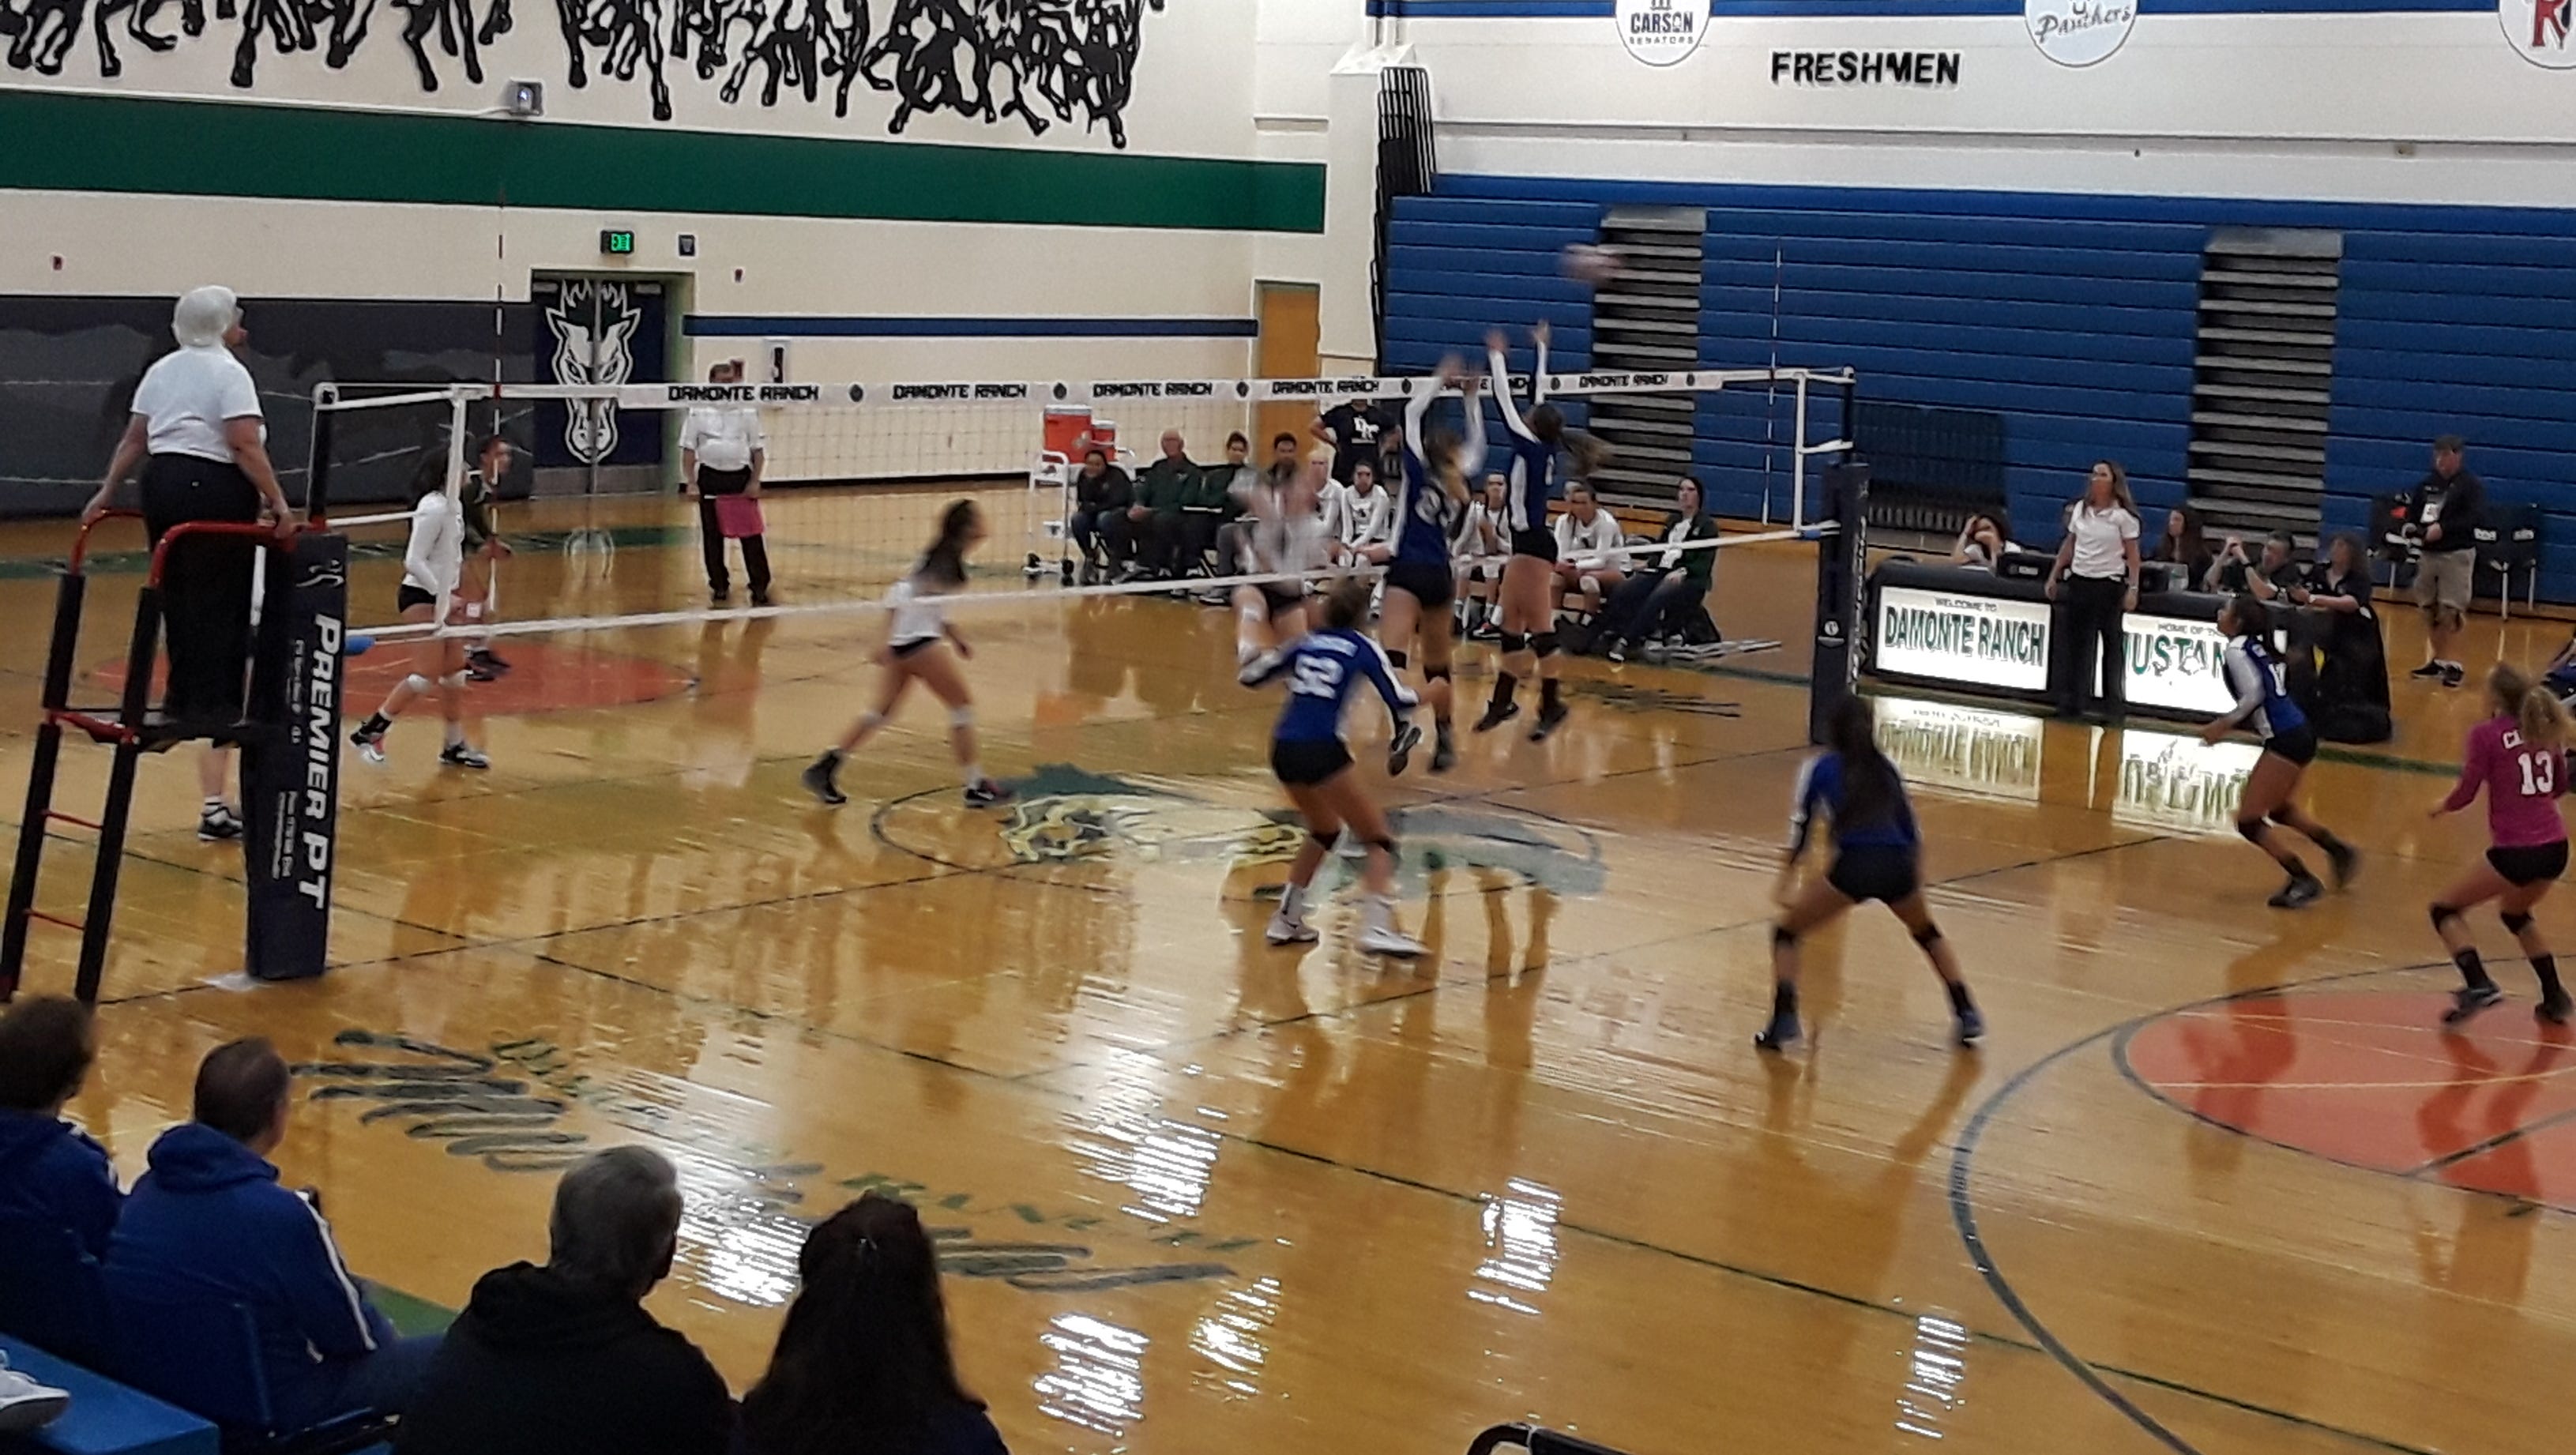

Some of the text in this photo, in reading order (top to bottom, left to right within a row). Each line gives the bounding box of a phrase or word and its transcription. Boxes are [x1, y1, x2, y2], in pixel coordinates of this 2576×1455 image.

[1630, 12, 1693, 33] CARSON
[1771, 51, 1961, 85] FRESHMEN
[668, 385, 819, 400] DAMONTE RANCH
[893, 384, 1026, 399] DAMONTE RANCH
[1093, 383, 1162, 397] DAMONTE
[1885, 606, 2045, 667] DAMONTE RANCH
[299, 613, 341, 909] PREMIER PT
[2518, 750, 2554, 795] 13
